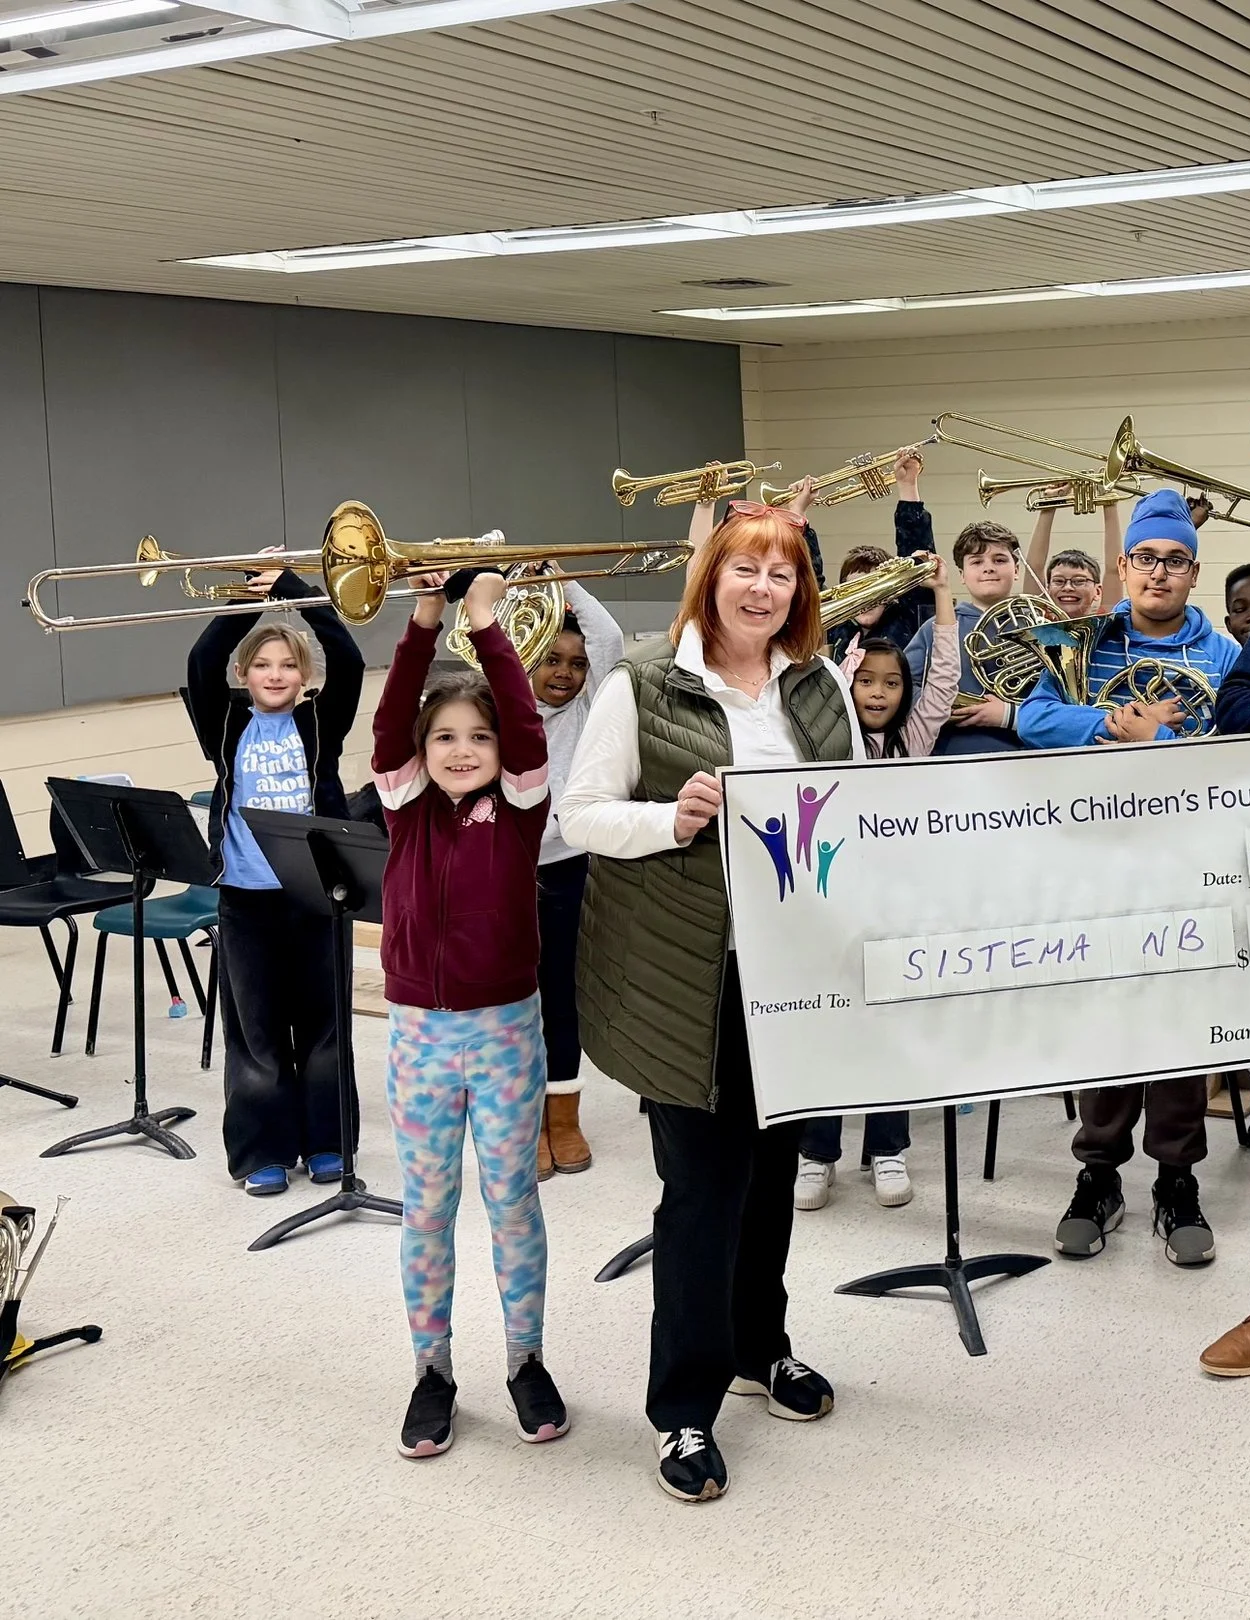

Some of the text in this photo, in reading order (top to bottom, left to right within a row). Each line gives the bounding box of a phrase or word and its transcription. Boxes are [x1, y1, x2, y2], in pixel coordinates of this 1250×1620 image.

[858, 813, 919, 839] New
[927, 799, 1062, 834] Brunswick
[1070, 789, 1200, 823] Children's
[1202, 871, 1243, 887] Date:
[902, 918, 1205, 981] SISTEMA NB
[1237, 948, 1250, 971] $
[749, 993, 852, 1017] Presented To:
